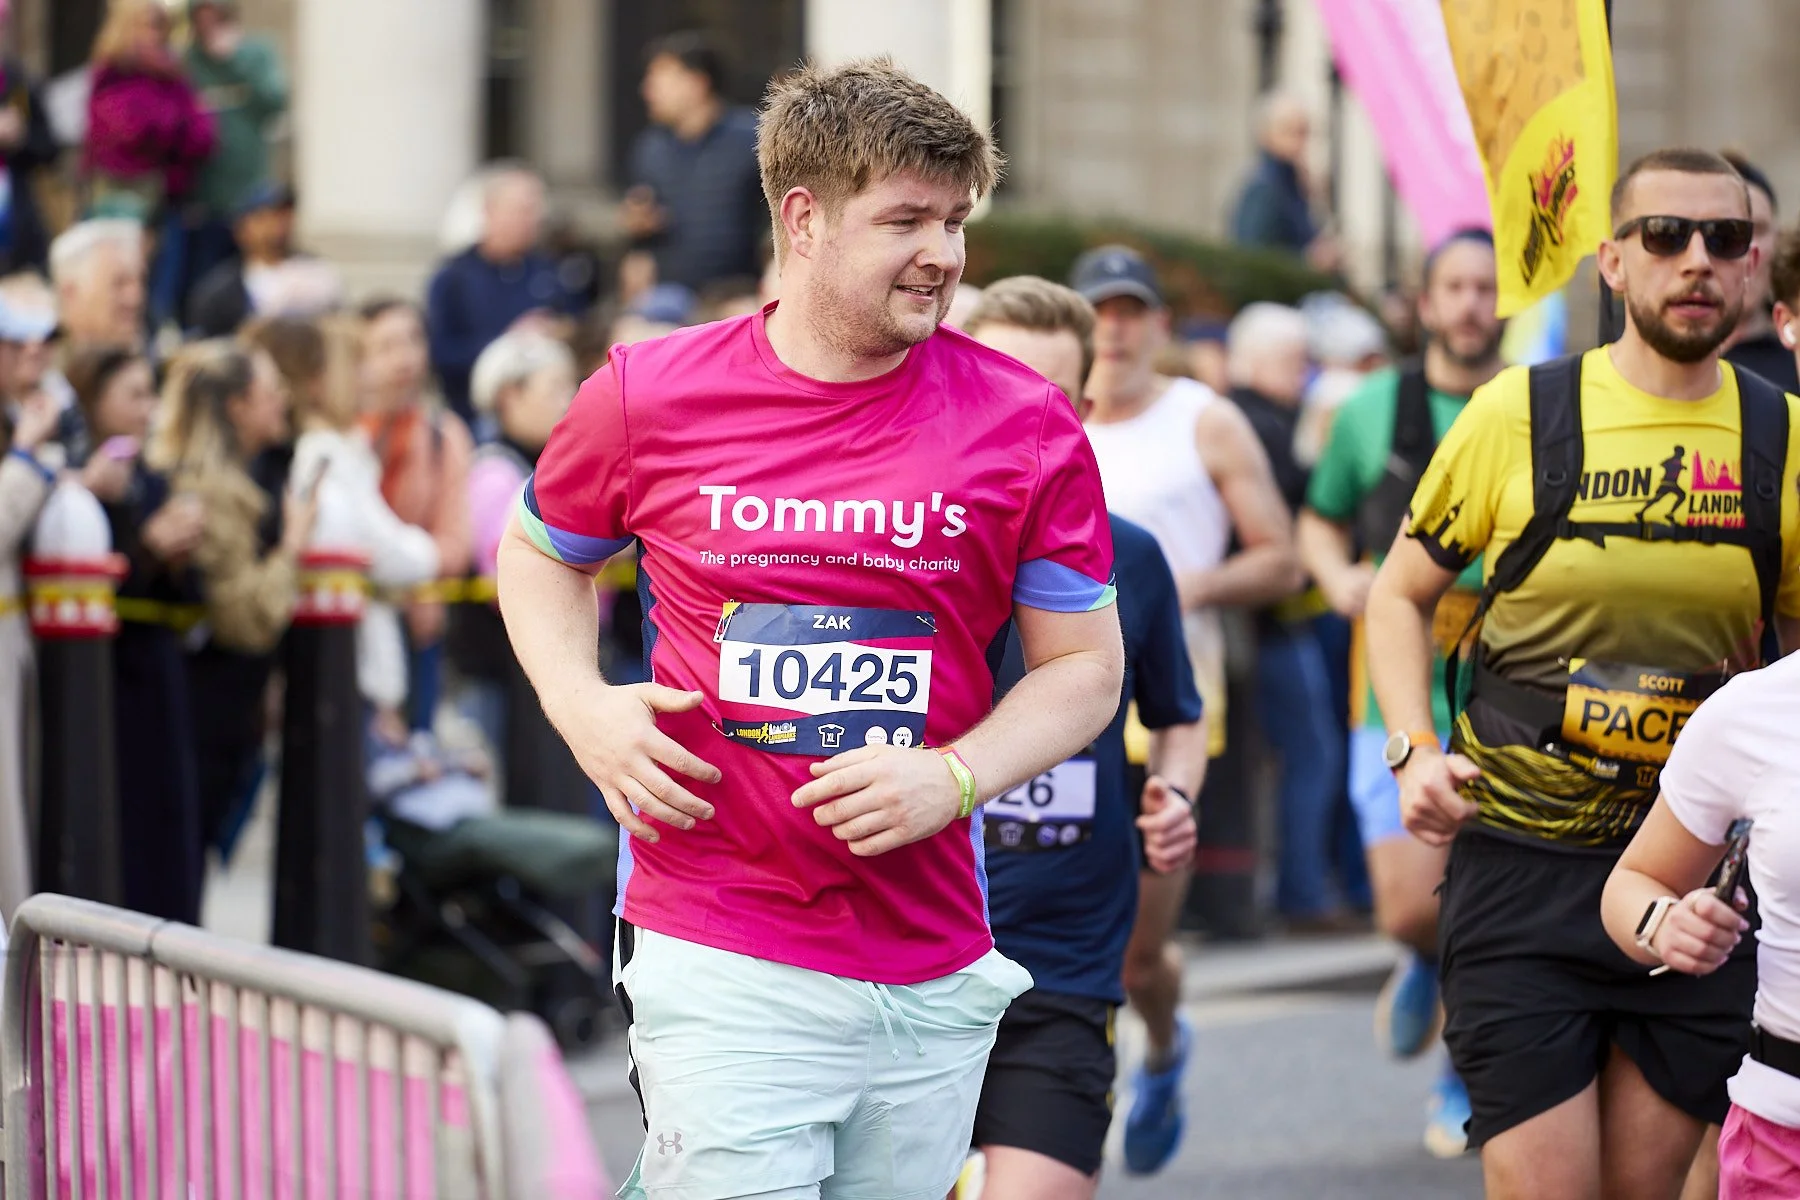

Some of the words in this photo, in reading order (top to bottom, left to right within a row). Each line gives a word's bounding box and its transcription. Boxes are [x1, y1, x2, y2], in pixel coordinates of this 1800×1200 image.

[699, 485, 967, 548] Tommy's
[700, 550, 726, 565] The
[730, 553, 820, 568] pregnancy
[825, 552, 858, 566] and
[863, 552, 905, 572] baby
[908, 555, 960, 573] charity
[812, 614, 852, 631] ZAK
[738, 648, 918, 705] 10425
[1638, 673, 1685, 694] SCOTT
[736, 728, 761, 738] LONDON
[826, 732, 835, 742] XL
[899, 738, 906, 747] 4
